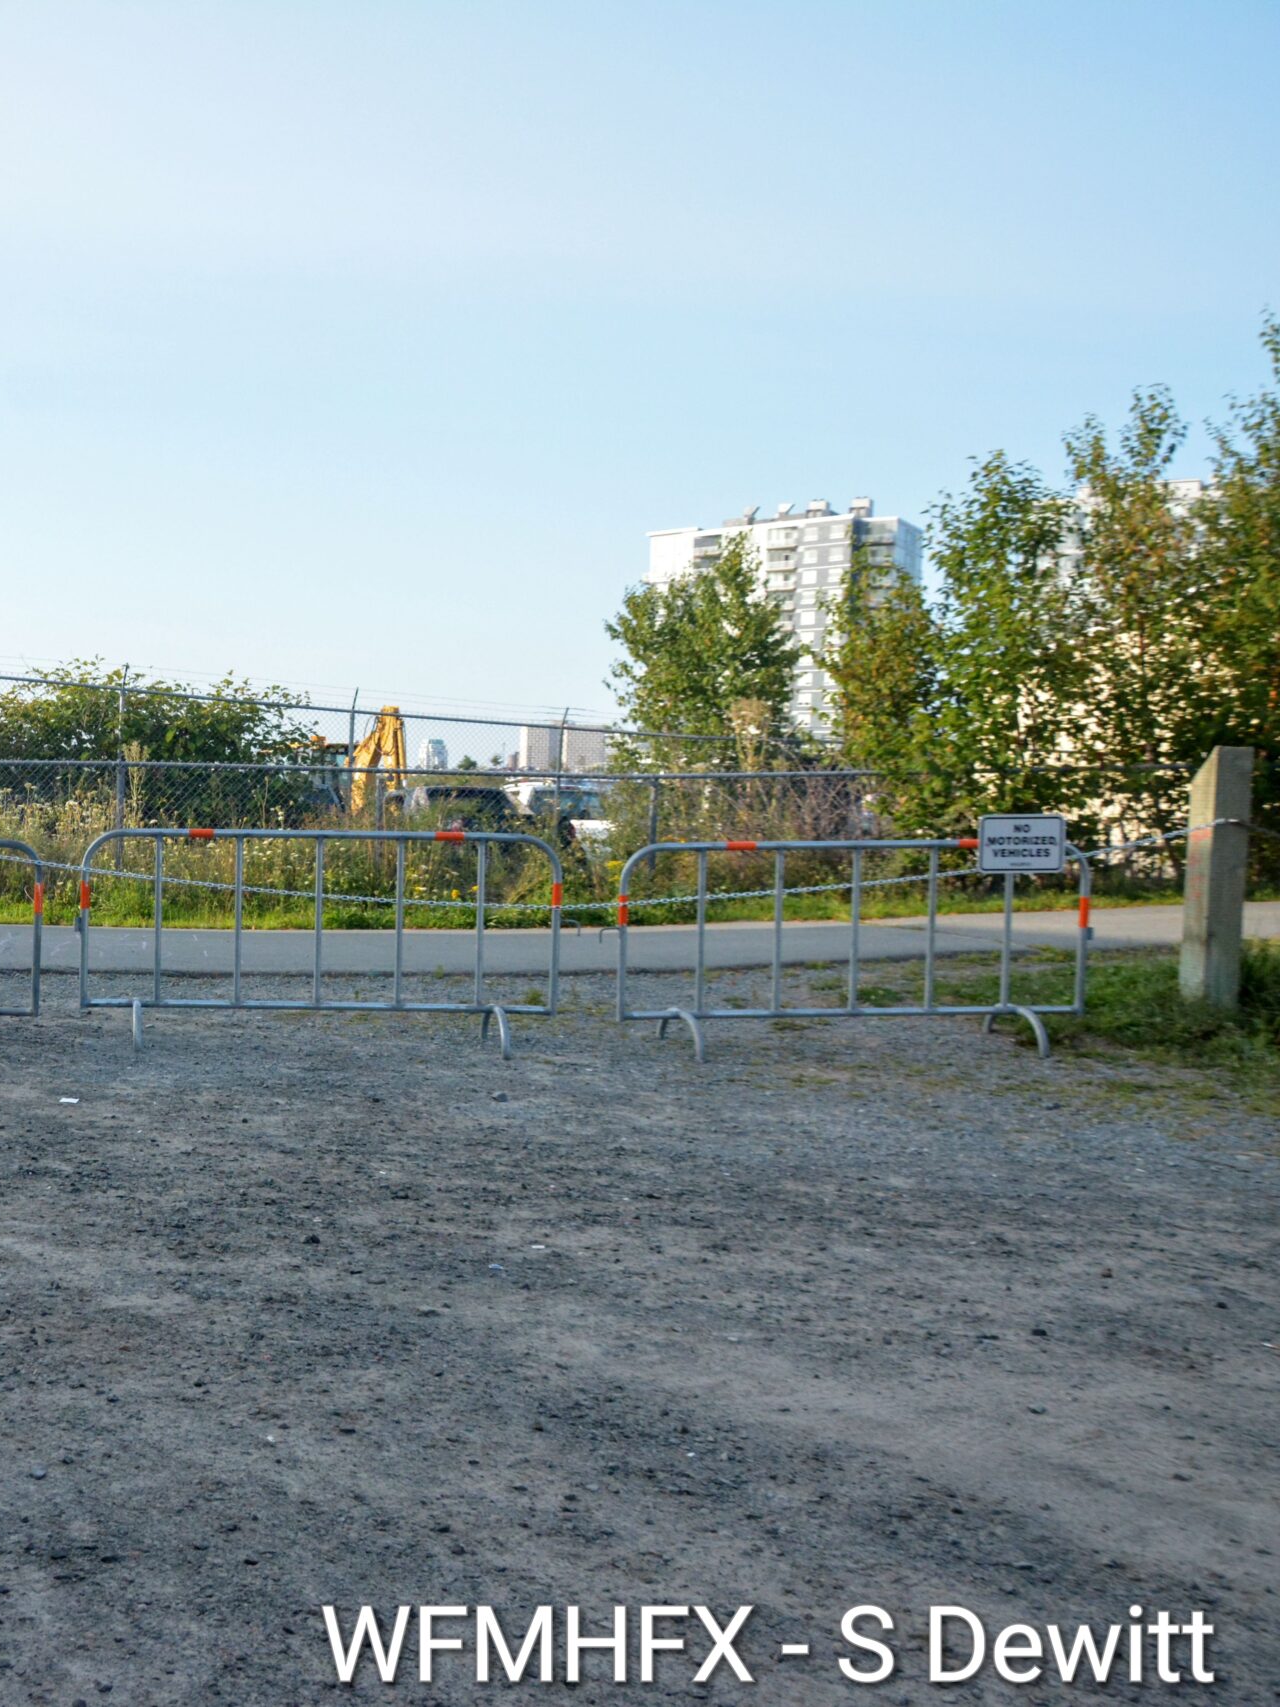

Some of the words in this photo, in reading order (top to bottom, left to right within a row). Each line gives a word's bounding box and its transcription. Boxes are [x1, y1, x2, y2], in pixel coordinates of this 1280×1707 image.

[1013, 824, 1031, 833] NO
[987, 836, 1057, 846] MOTORIZED
[992, 848, 1051, 858] VEHICLES
